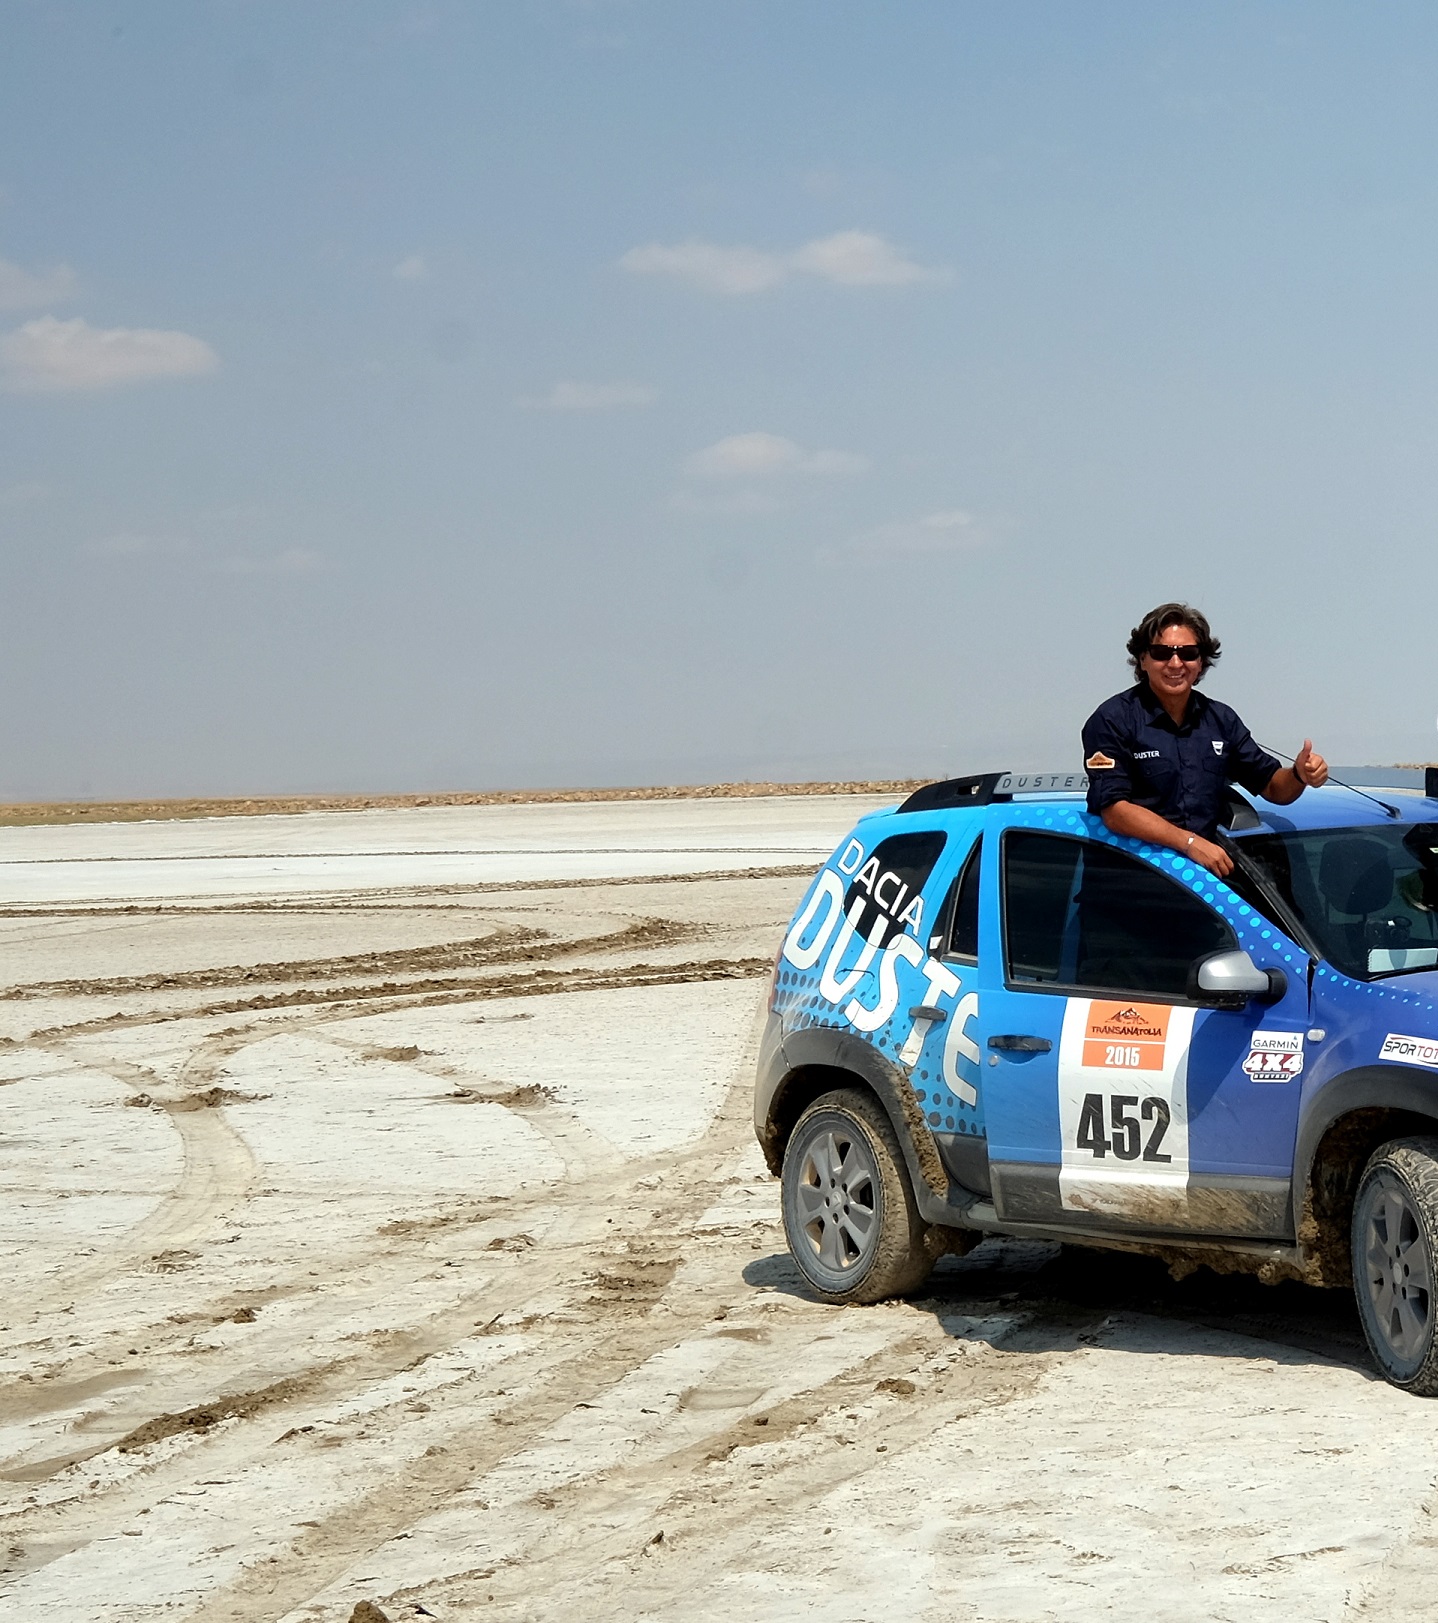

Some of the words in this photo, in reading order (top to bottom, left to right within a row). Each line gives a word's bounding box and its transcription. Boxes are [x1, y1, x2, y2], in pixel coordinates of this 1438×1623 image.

[1002, 776, 1088, 789] DUSTER
[836, 837, 924, 936] DACIA
[1091, 1025, 1162, 1037] TRANSANATOLIA
[1252, 1039, 1299, 1050] GARMIN
[1104, 1045, 1141, 1067] 2015
[1243, 1052, 1302, 1073] 4X4
[1076, 1092, 1172, 1164] 452
